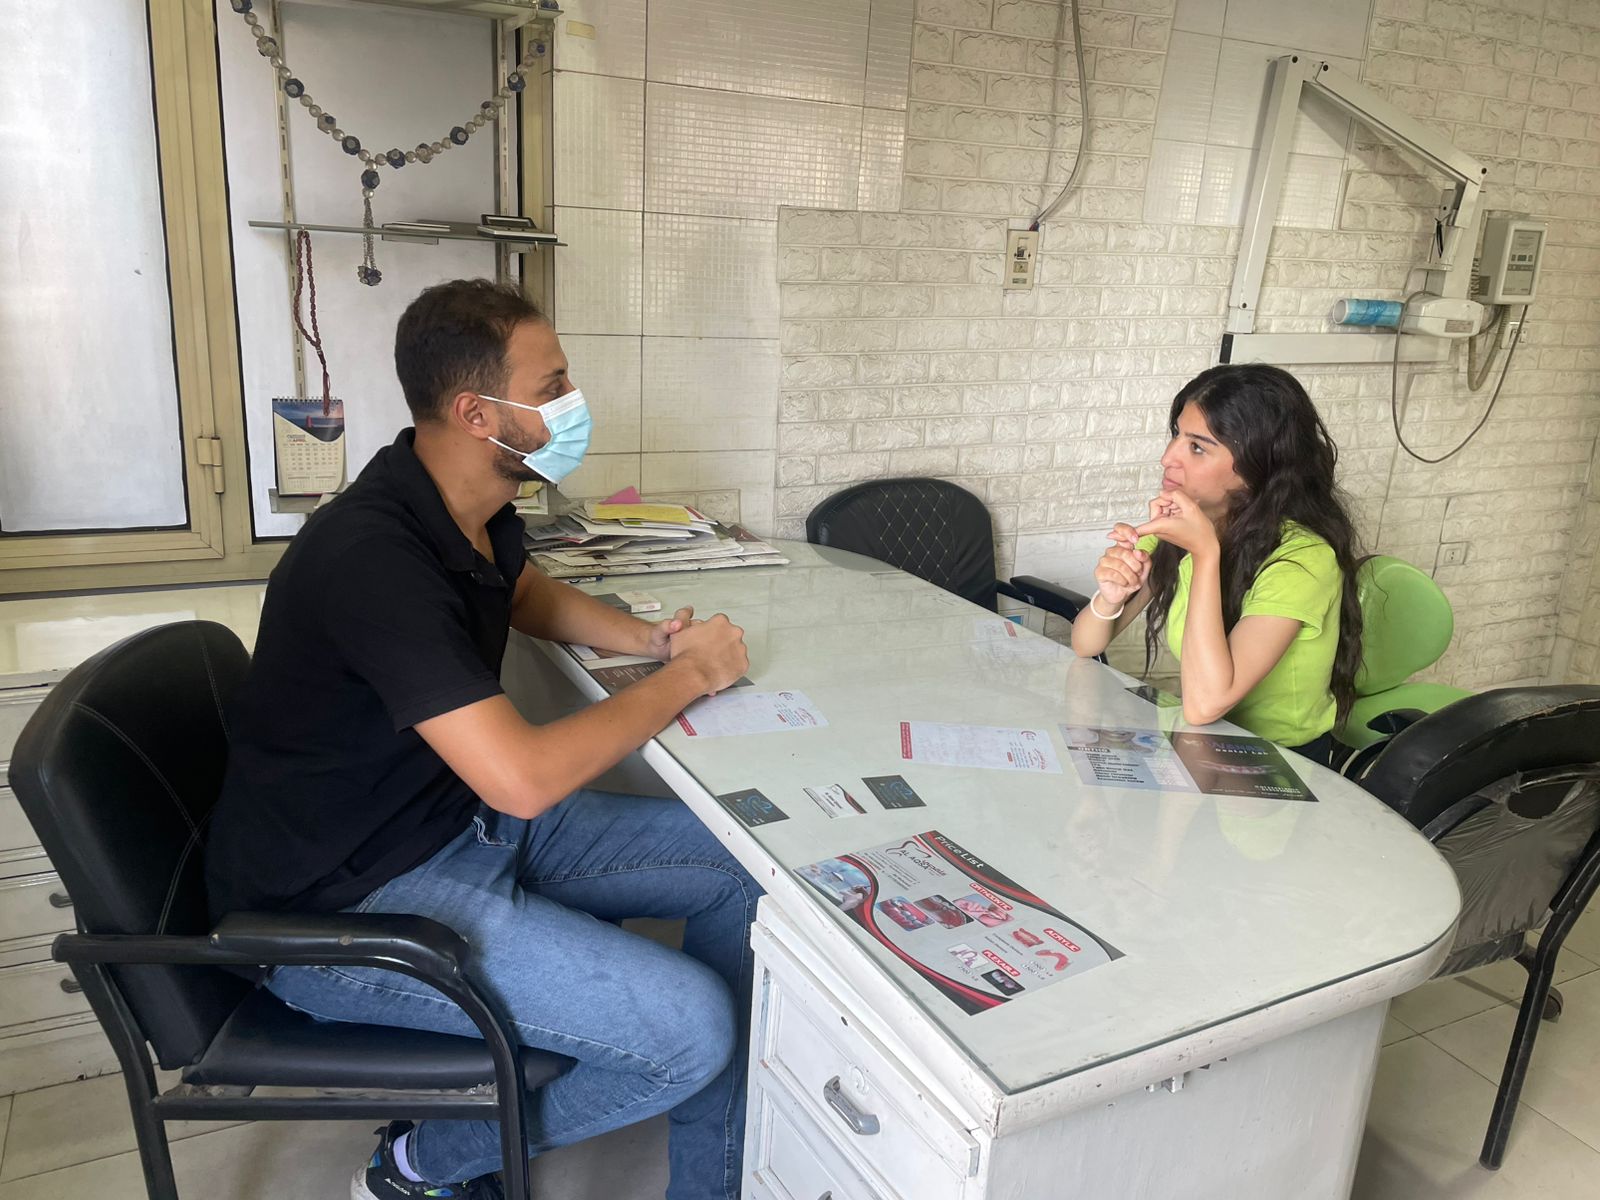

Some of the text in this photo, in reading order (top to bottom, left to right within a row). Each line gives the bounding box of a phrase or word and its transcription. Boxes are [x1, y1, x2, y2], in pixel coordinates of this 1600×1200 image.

[935, 835, 962, 855] Price
[960, 853, 984, 869] List
[1045, 928, 1080, 952] ACRYLIC
